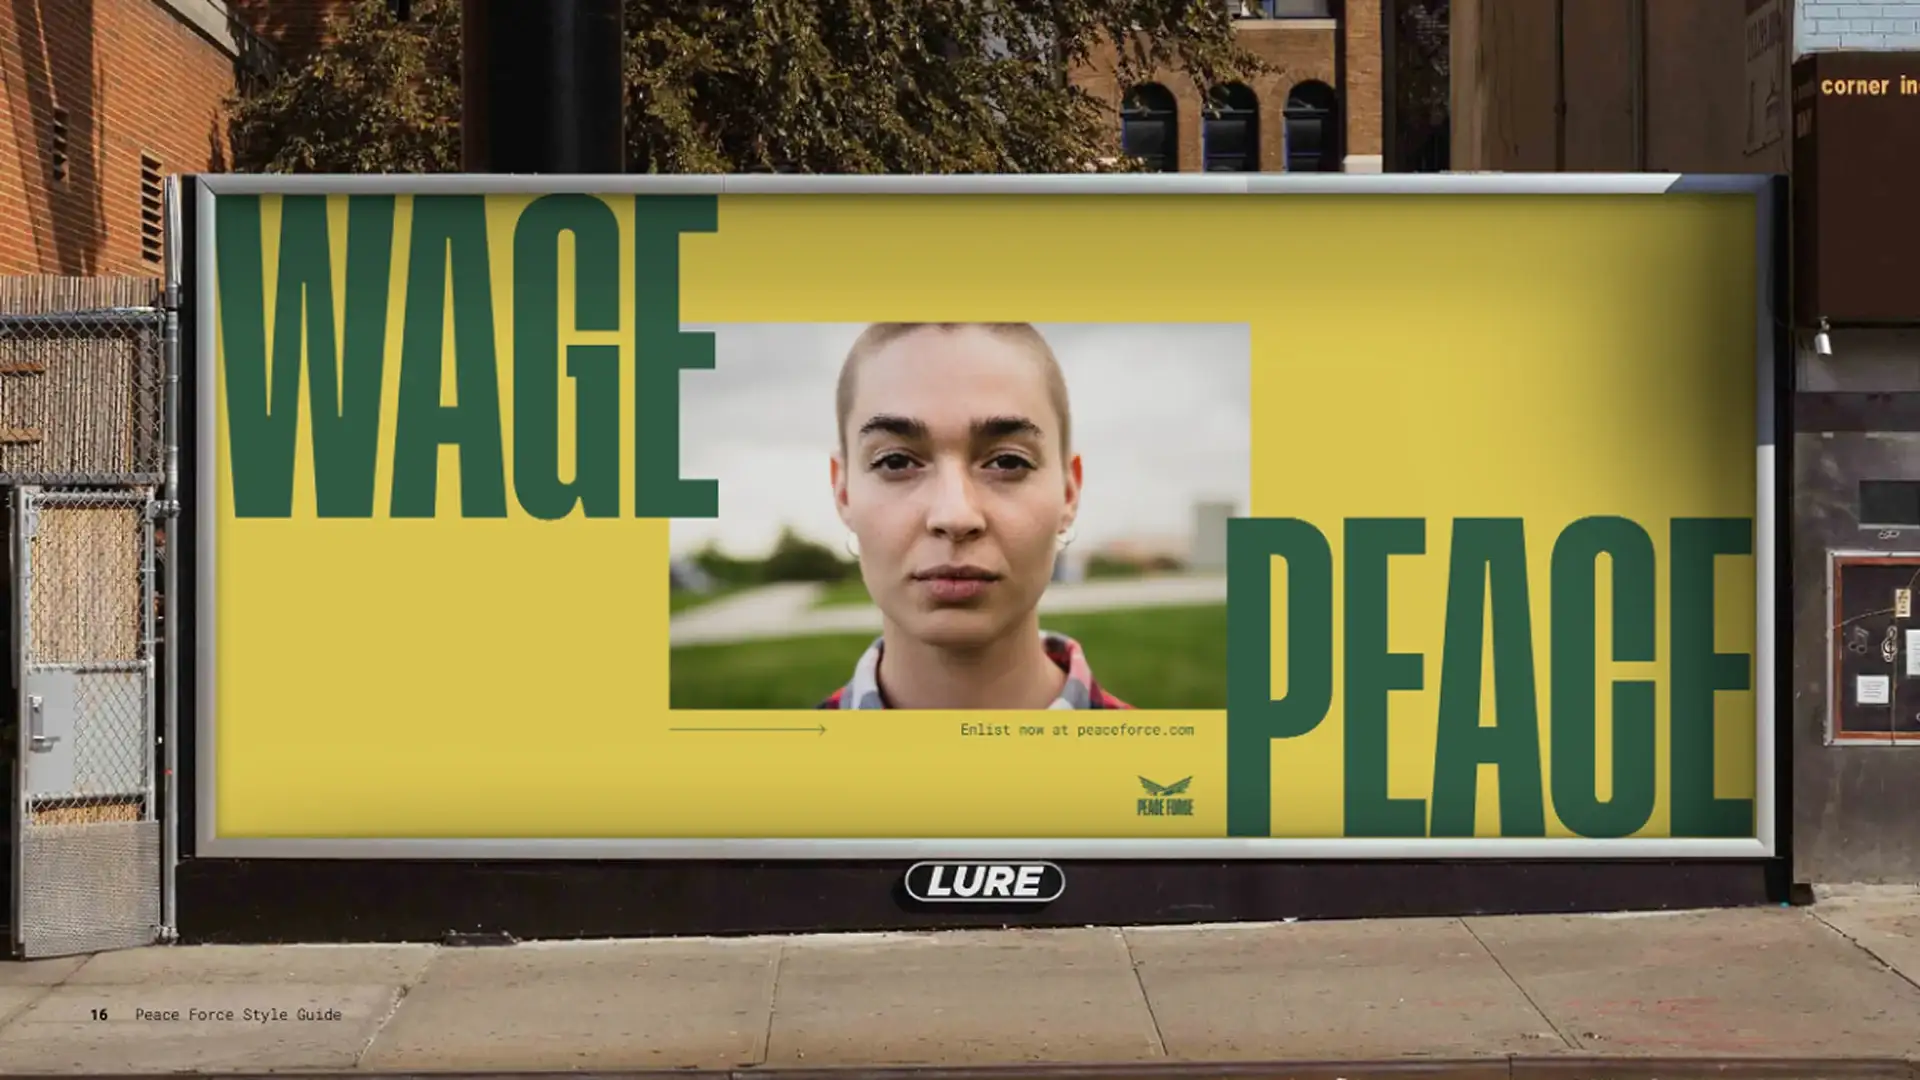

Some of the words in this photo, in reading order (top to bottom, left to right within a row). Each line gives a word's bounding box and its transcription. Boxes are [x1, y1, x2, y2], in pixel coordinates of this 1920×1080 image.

[1821, 79, 1890, 95] corner
[1900, 75, 1920, 95] in
[215, 193, 719, 521] WAGE
[1227, 516, 1754, 839] PEACE
[960, 723, 1011, 736] Enlist
[1019, 726, 1044, 736] now
[1052, 725, 1068, 736] at
[1077, 723, 1195, 738] peaceforce.com
[927, 866, 1045, 897] LURE
